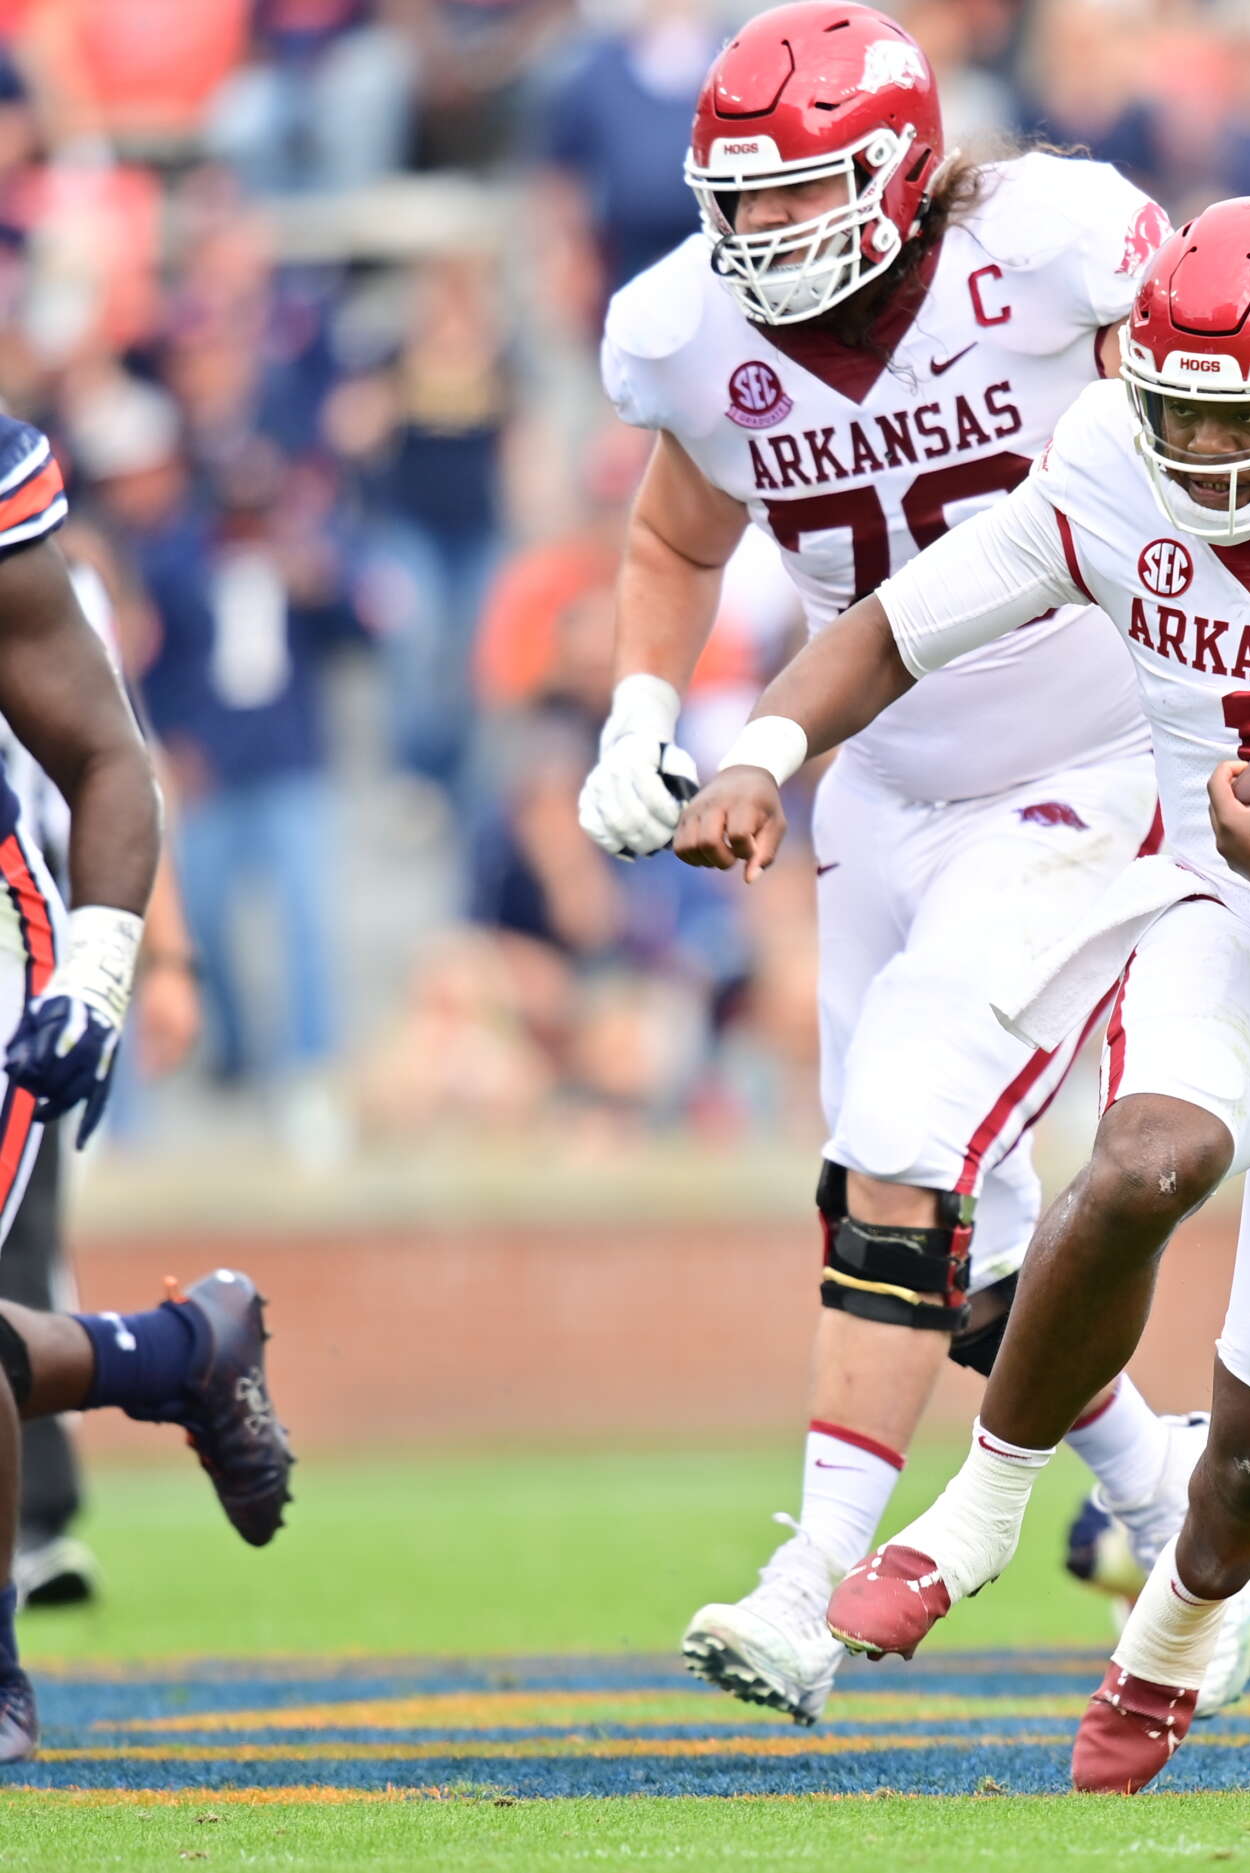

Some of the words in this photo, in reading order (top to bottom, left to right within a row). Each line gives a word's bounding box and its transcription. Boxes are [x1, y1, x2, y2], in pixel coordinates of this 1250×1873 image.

[723, 142, 759, 155] HOGS
[968, 264, 1012, 328] C
[733, 364, 777, 411] SEC
[1179, 357, 1221, 373] HOGS
[748, 380, 1023, 490] ARKANSAS
[1142, 541, 1190, 595] SEC
